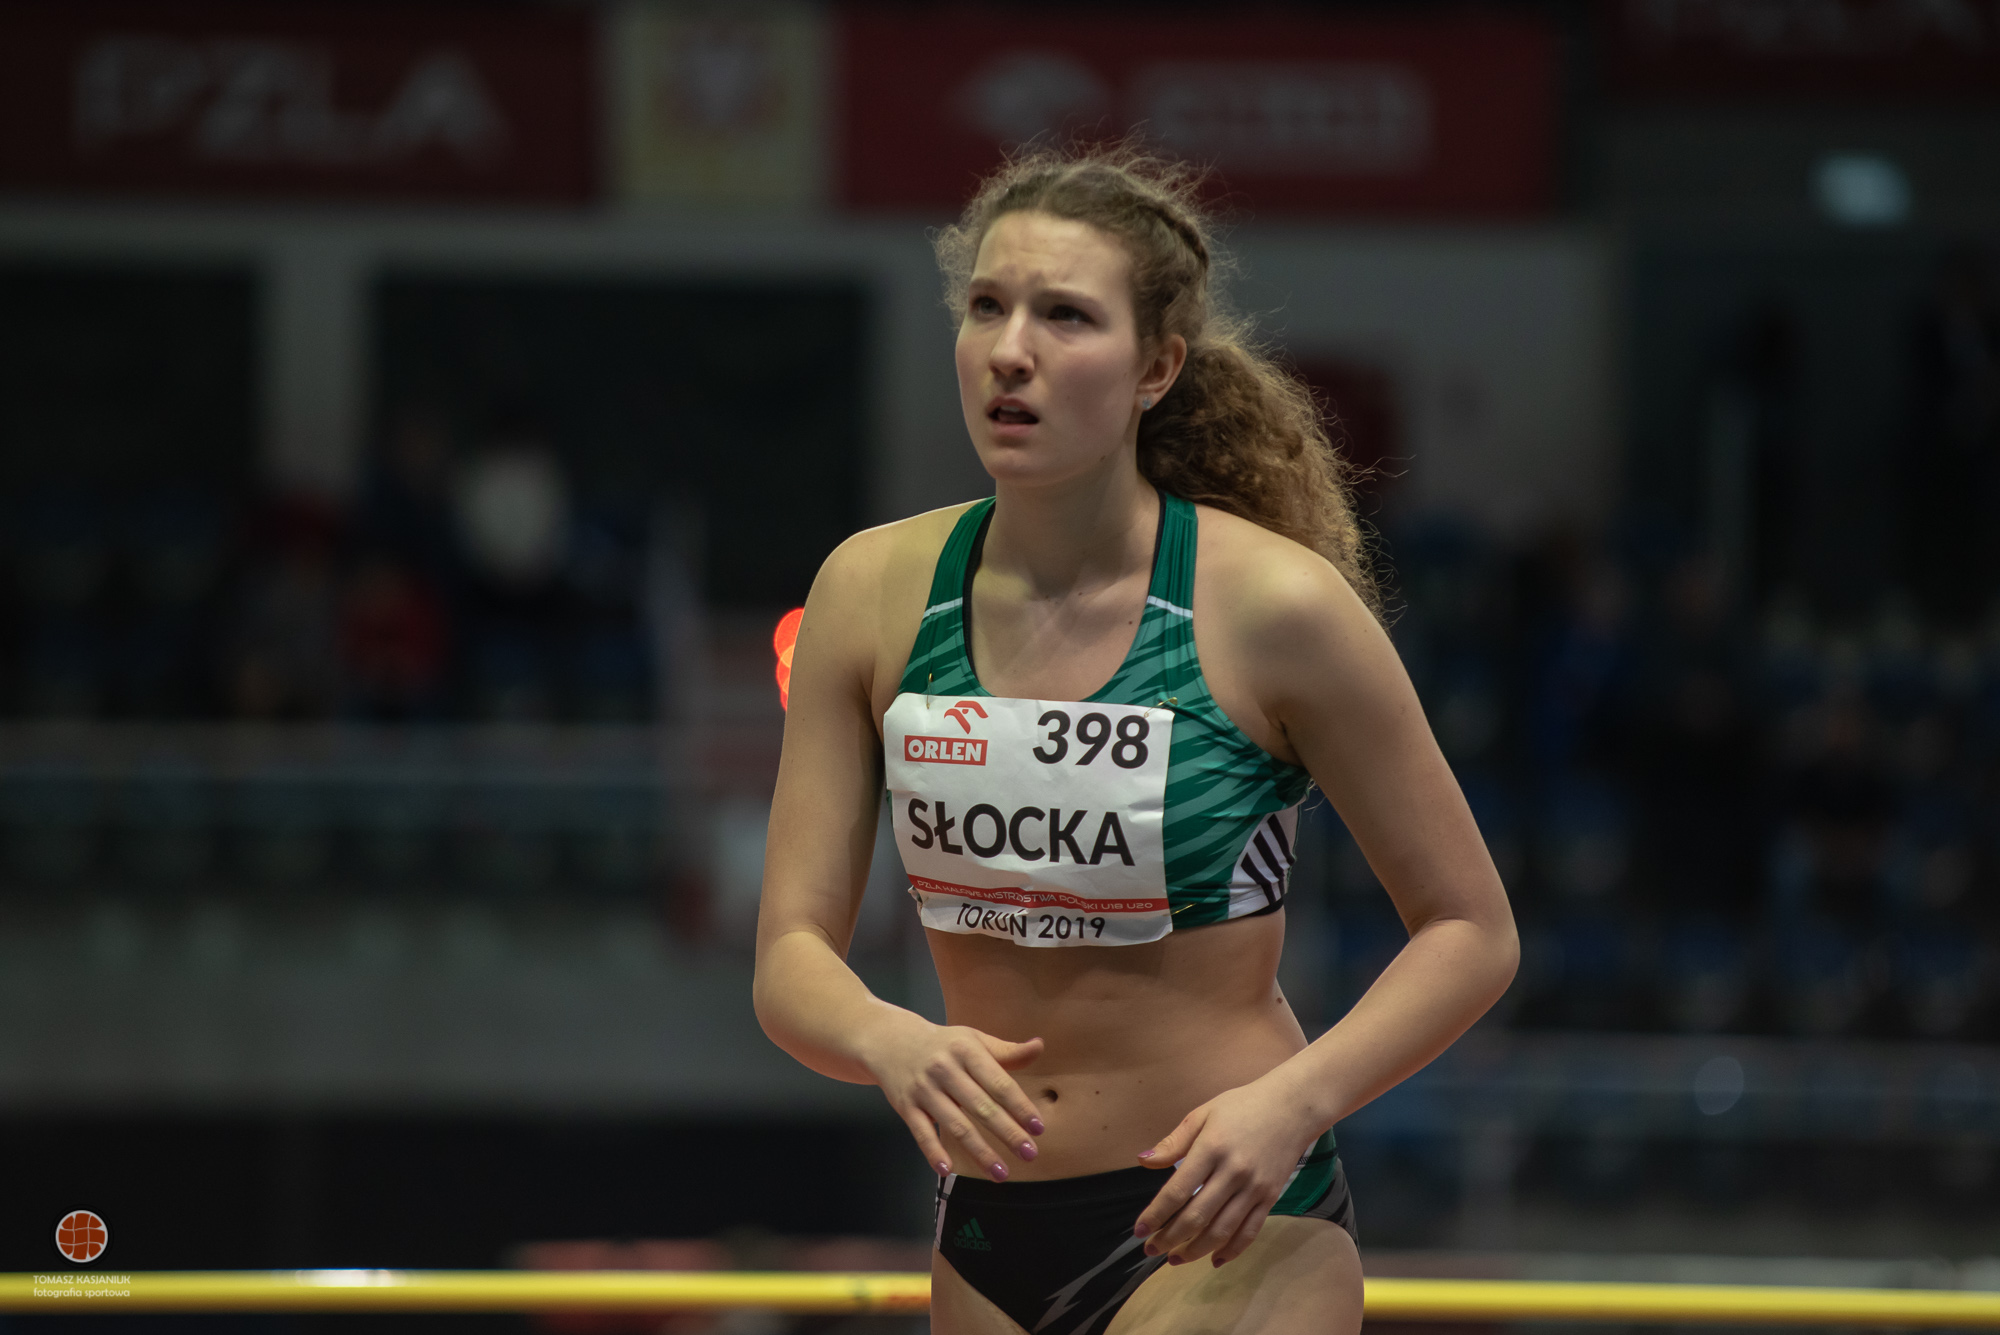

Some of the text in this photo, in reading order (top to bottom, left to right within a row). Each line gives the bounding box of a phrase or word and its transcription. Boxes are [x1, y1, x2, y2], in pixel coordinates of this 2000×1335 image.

[907, 739, 983, 762] ORLEN
[1032, 710, 1150, 769] 398
[908, 798, 1136, 867] SŁOCKA
[917, 880, 942, 891] PZLA
[1059, 895, 1098, 910] POLSKI
[1126, 902, 1153, 910] U20
[956, 902, 1105, 939] TORUŃ 2019
[953, 1236, 992, 1252] adidas
